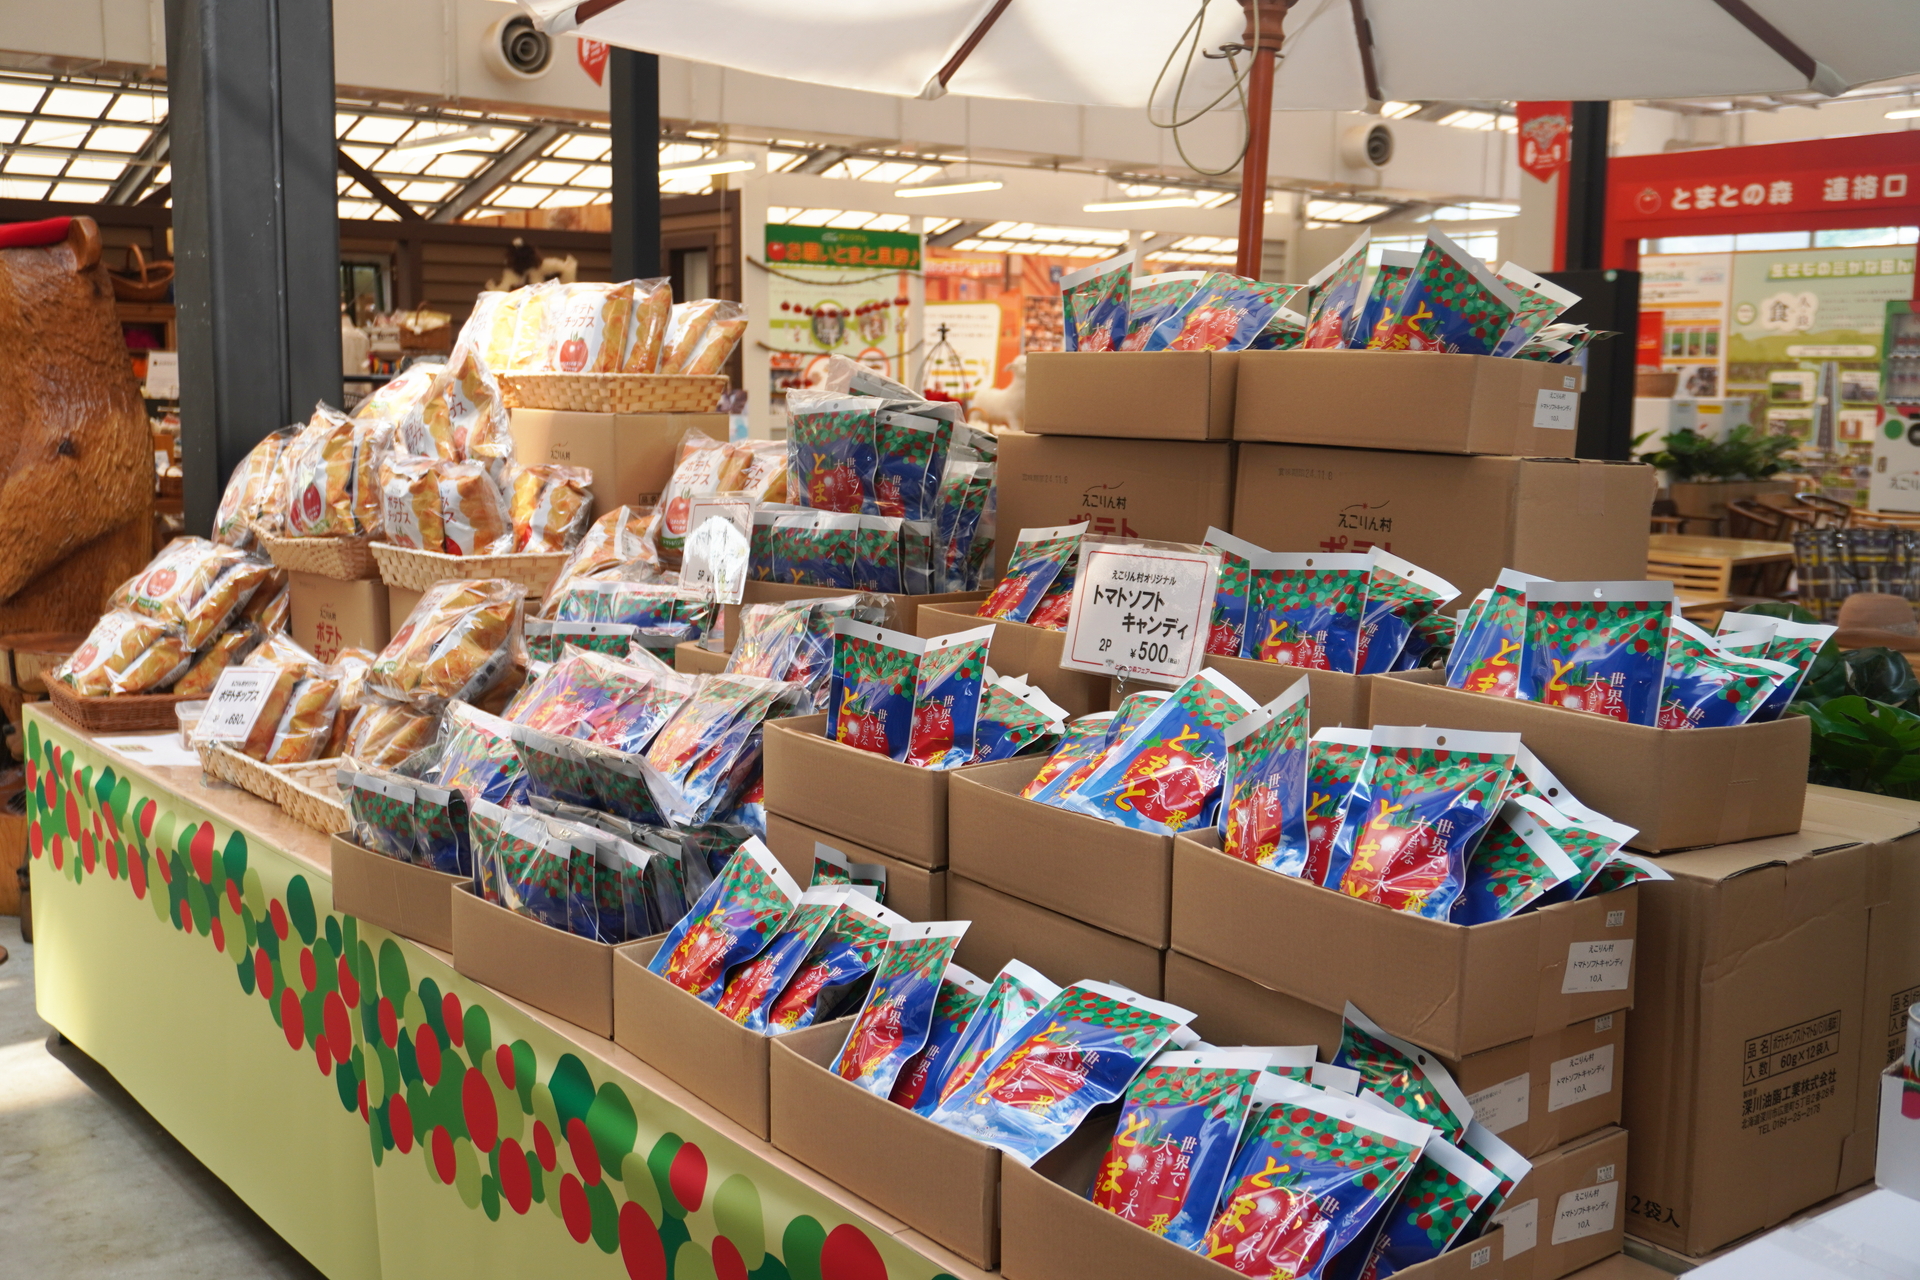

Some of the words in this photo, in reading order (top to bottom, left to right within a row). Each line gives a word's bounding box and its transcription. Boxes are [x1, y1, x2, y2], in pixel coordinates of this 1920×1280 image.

[1671, 180, 1793, 210] とまとの森
[1823, 174, 1908, 202] 連絡口
[564, 315, 594, 328] チップス
[674, 473, 710, 486] チップス
[685, 461, 711, 473] ポテト
[813, 453, 828, 503] とま
[388, 496, 405, 509] ポテト
[1082, 494, 1127, 510] えこりん村
[388, 511, 411, 525] チップス
[1338, 514, 1392, 533] えこりん村
[1112, 570, 1177, 586] えこりん村オリジナル
[1094, 584, 1165, 612] トマトソフト
[316, 622, 343, 643] ポテト
[1122, 612, 1189, 640] キャンディ
[1099, 638, 1112, 652] 2P
[1311, 630, 1328, 670] 世界で
[219, 690, 260, 702] ポテトチップス
[1604, 672, 1627, 717] 世界で
[860, 706, 875, 746] 大きな
[923, 695, 940, 734] 大きな
[873, 708, 888, 748] 世界で
[929, 695, 955, 766] 世界で一番
[1114, 724, 1200, 813] とまと
[1179, 752, 1216, 786] 大きな
[1255, 773, 1281, 865] 世界で一番
[1401, 815, 1432, 866] 大きな
[1402, 818, 1455, 913] 世界で一番
[1588, 944, 1614, 953] えこりん村
[1573, 958, 1623, 969] トマトソフトキャンディ
[1589, 973, 1602, 982] 10入
[861, 994, 907, 1077] 世界で一番
[975, 1021, 1067, 1105] とまと
[1569, 1053, 1595, 1067] えこりん村
[1556, 1064, 1605, 1086] トマトソフトキャンディ
[1742, 1068, 1837, 1117] 深川油脂工業株式会社
[1758, 1124, 1770, 1135] TEL
[1148, 1133, 1178, 1185] 大きな
[1146, 1136, 1198, 1237] 世界で一番
[1574, 1189, 1599, 1202] えこりん村
[1561, 1201, 1609, 1220] トマトソフトキャンディ
[1577, 1219, 1590, 1229] 10入
